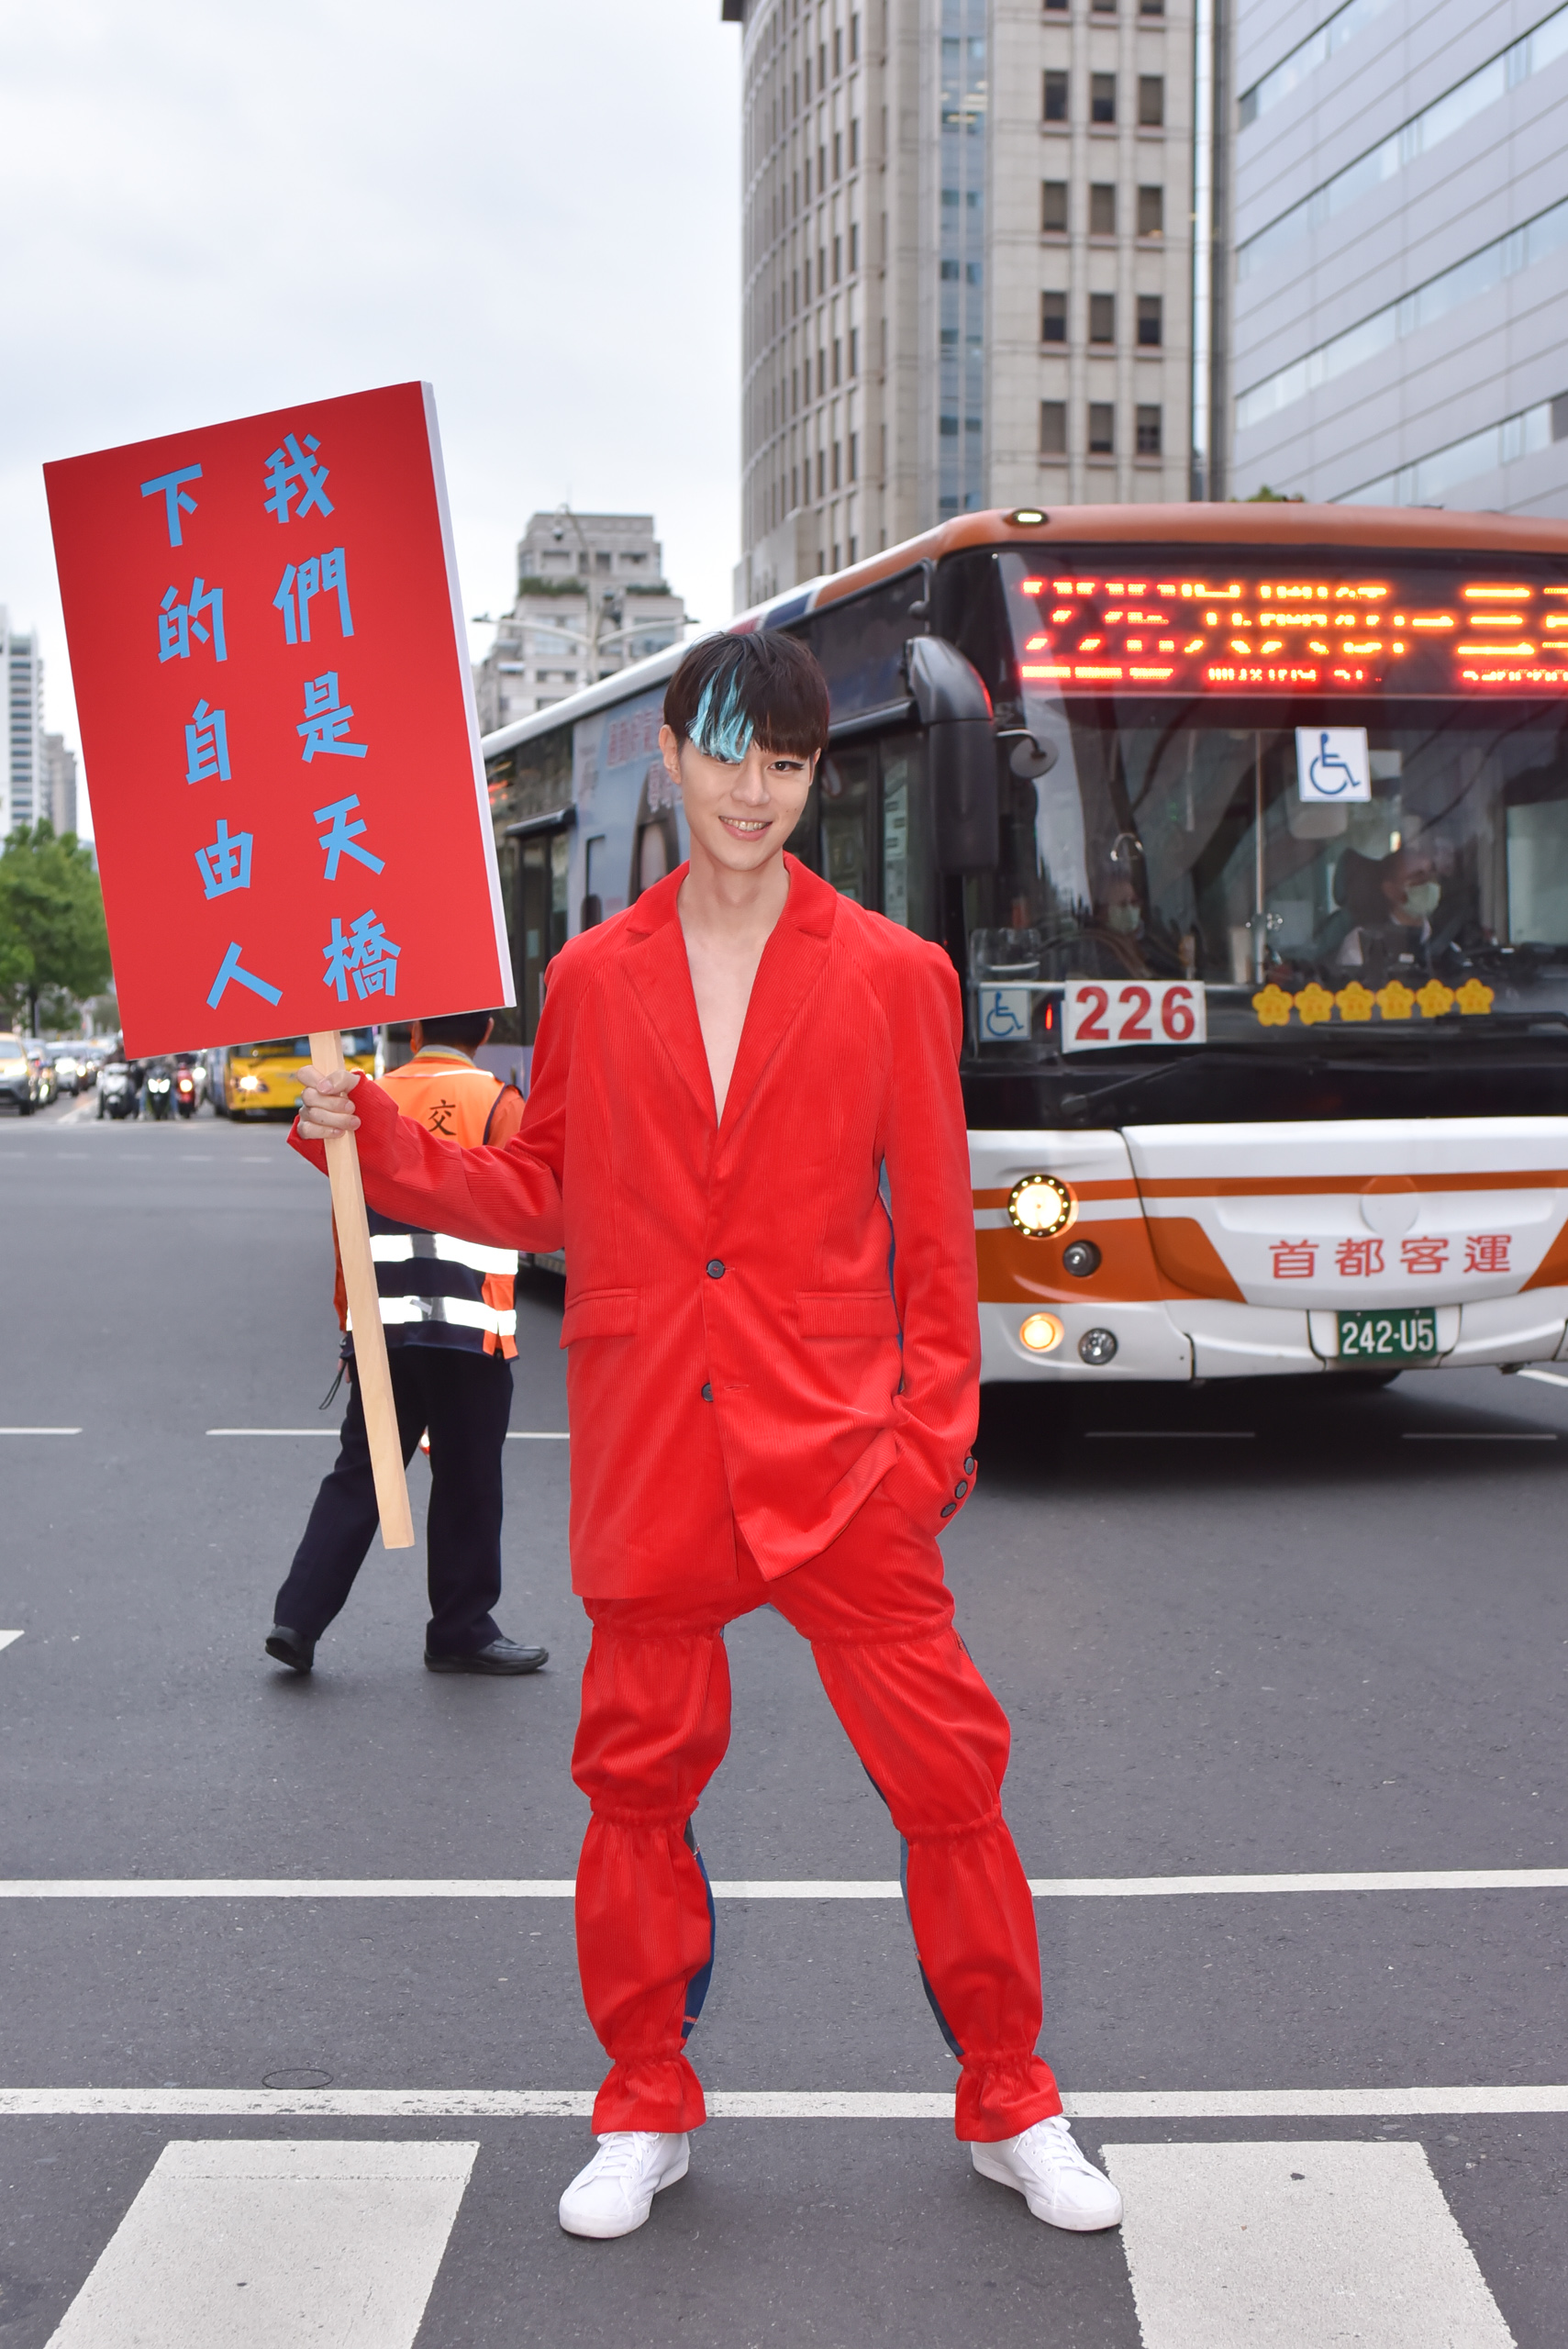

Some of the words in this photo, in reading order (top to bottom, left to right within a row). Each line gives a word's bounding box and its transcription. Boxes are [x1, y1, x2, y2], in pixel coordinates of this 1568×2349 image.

[140, 463, 283, 1009] 下的自由人
[263, 433, 401, 1002] 我們是天橋
[1074, 985, 1195, 1041] 226
[428, 1098, 457, 1136] 交
[1269, 1234, 1512, 1280] 首都客運
[1341, 1319, 1434, 1354] 242-U5
